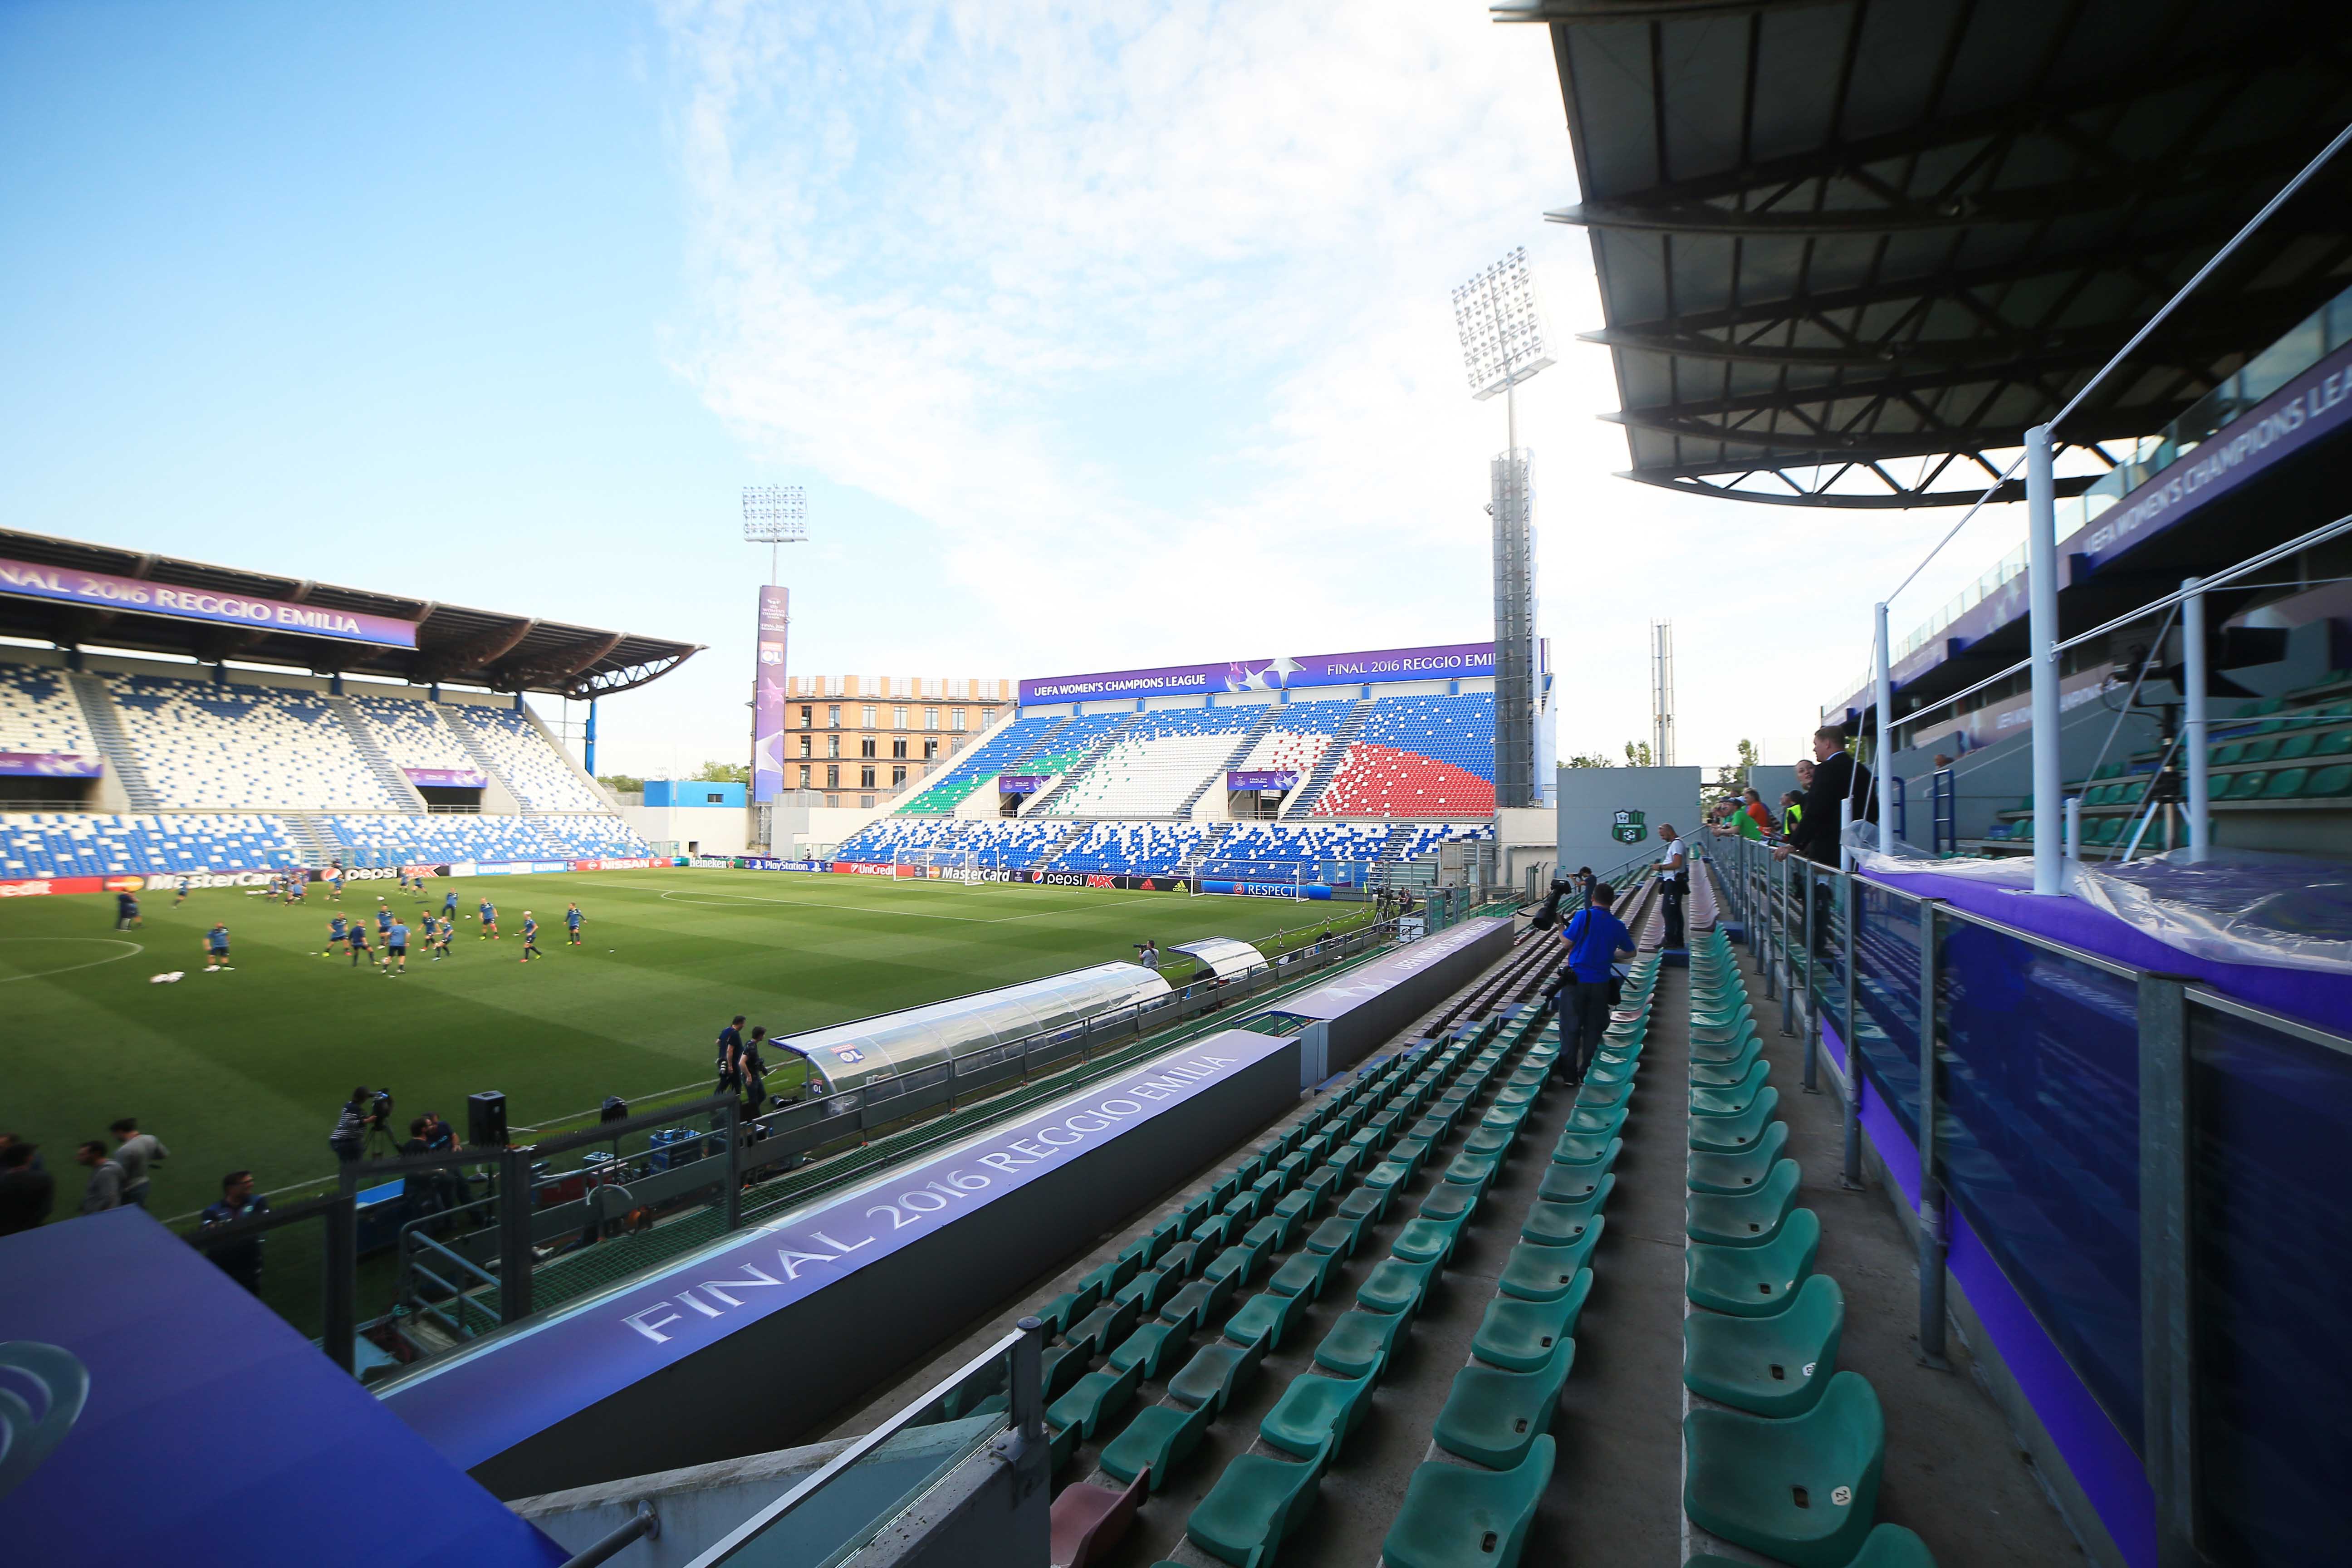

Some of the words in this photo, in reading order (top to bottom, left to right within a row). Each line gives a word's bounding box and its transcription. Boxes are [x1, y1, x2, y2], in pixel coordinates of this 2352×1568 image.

[2183, 397, 2305, 494] CHAMPIONS
[2307, 364, 2352, 418] LE
[78, 577, 150, 604] 2016
[155, 588, 272, 621] REGGIO
[277, 605, 362, 634] EMILIA
[1327, 662, 1367, 675] FINAL
[1371, 660, 1400, 672] 2016
[1403, 655, 1461, 671] REGGIO
[1034, 686, 1058, 696] UEFA
[1059, 682, 1103, 695] WOMEN'S
[1105, 677, 1163, 691] CHAMPIONS
[1166, 674, 1205, 687] LEAGUE
[601, 859, 650, 870] NISSAN
[689, 858, 727, 868] Heineken
[344, 866, 398, 881] pepsi
[1047, 873, 1083, 886] pepsi
[1085, 874, 1118, 889] MAX
[1248, 885, 1295, 897] RESPECT
[840, 1050, 865, 1062] OL
[622, 1230, 876, 1345] FINAL
[865, 1169, 991, 1231] 2016
[976, 1098, 1143, 1174] REGGIO
[1128, 1054, 1238, 1102] EMILIA
